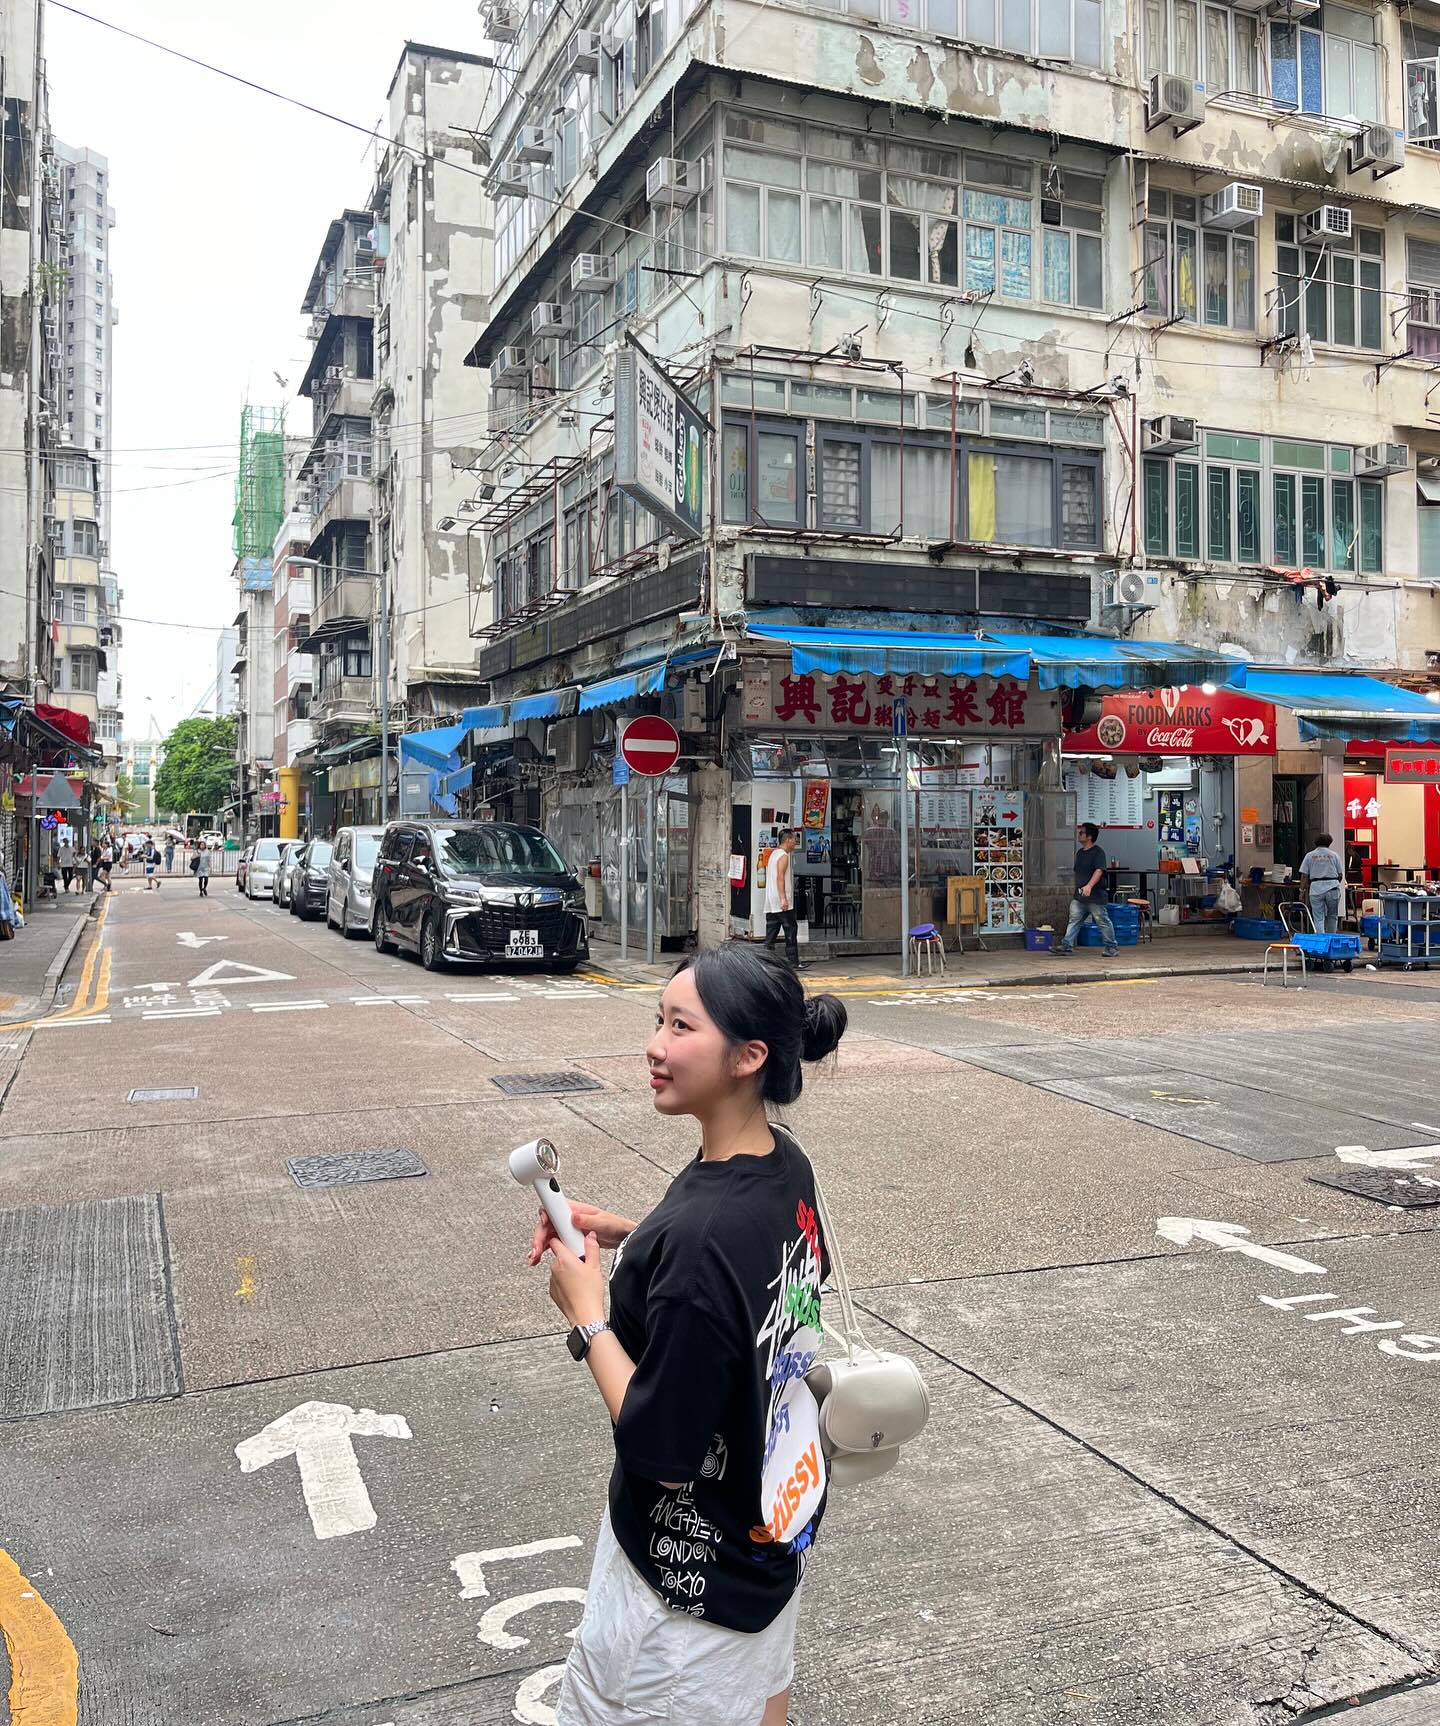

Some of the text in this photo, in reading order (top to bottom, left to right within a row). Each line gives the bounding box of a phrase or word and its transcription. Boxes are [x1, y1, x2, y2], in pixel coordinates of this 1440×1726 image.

[774, 674, 872, 725] 興記
[943, 678, 1028, 729] 菜館
[1128, 704, 1212, 727] FOODMARKS
[512, 937, 536, 946] 9983
[649, 1531, 717, 1564] LONDON
[654, 1562, 706, 1598] TOKYO
